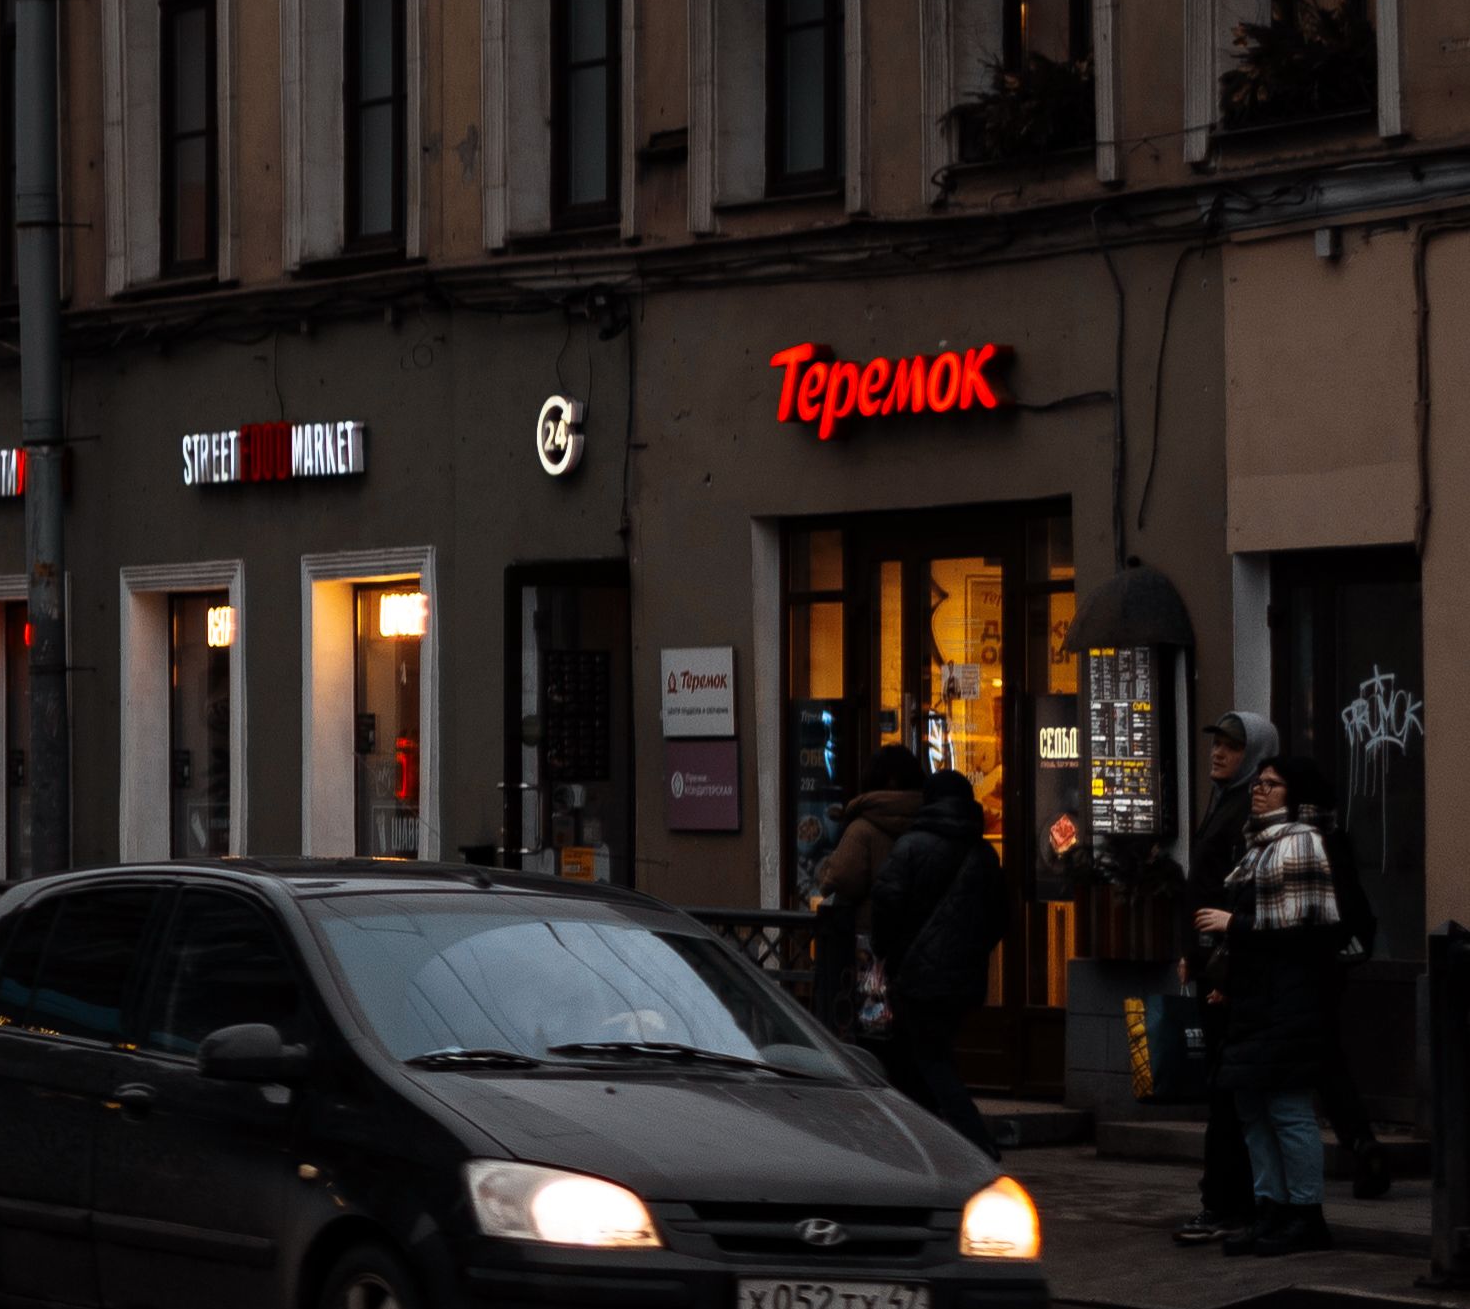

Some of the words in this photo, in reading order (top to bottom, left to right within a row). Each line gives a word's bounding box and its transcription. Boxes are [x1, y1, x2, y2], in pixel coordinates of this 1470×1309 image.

[770, 343, 997, 441] Теремок
[544, 420, 567, 450] 24
[681, 670, 728, 693] Теремок
